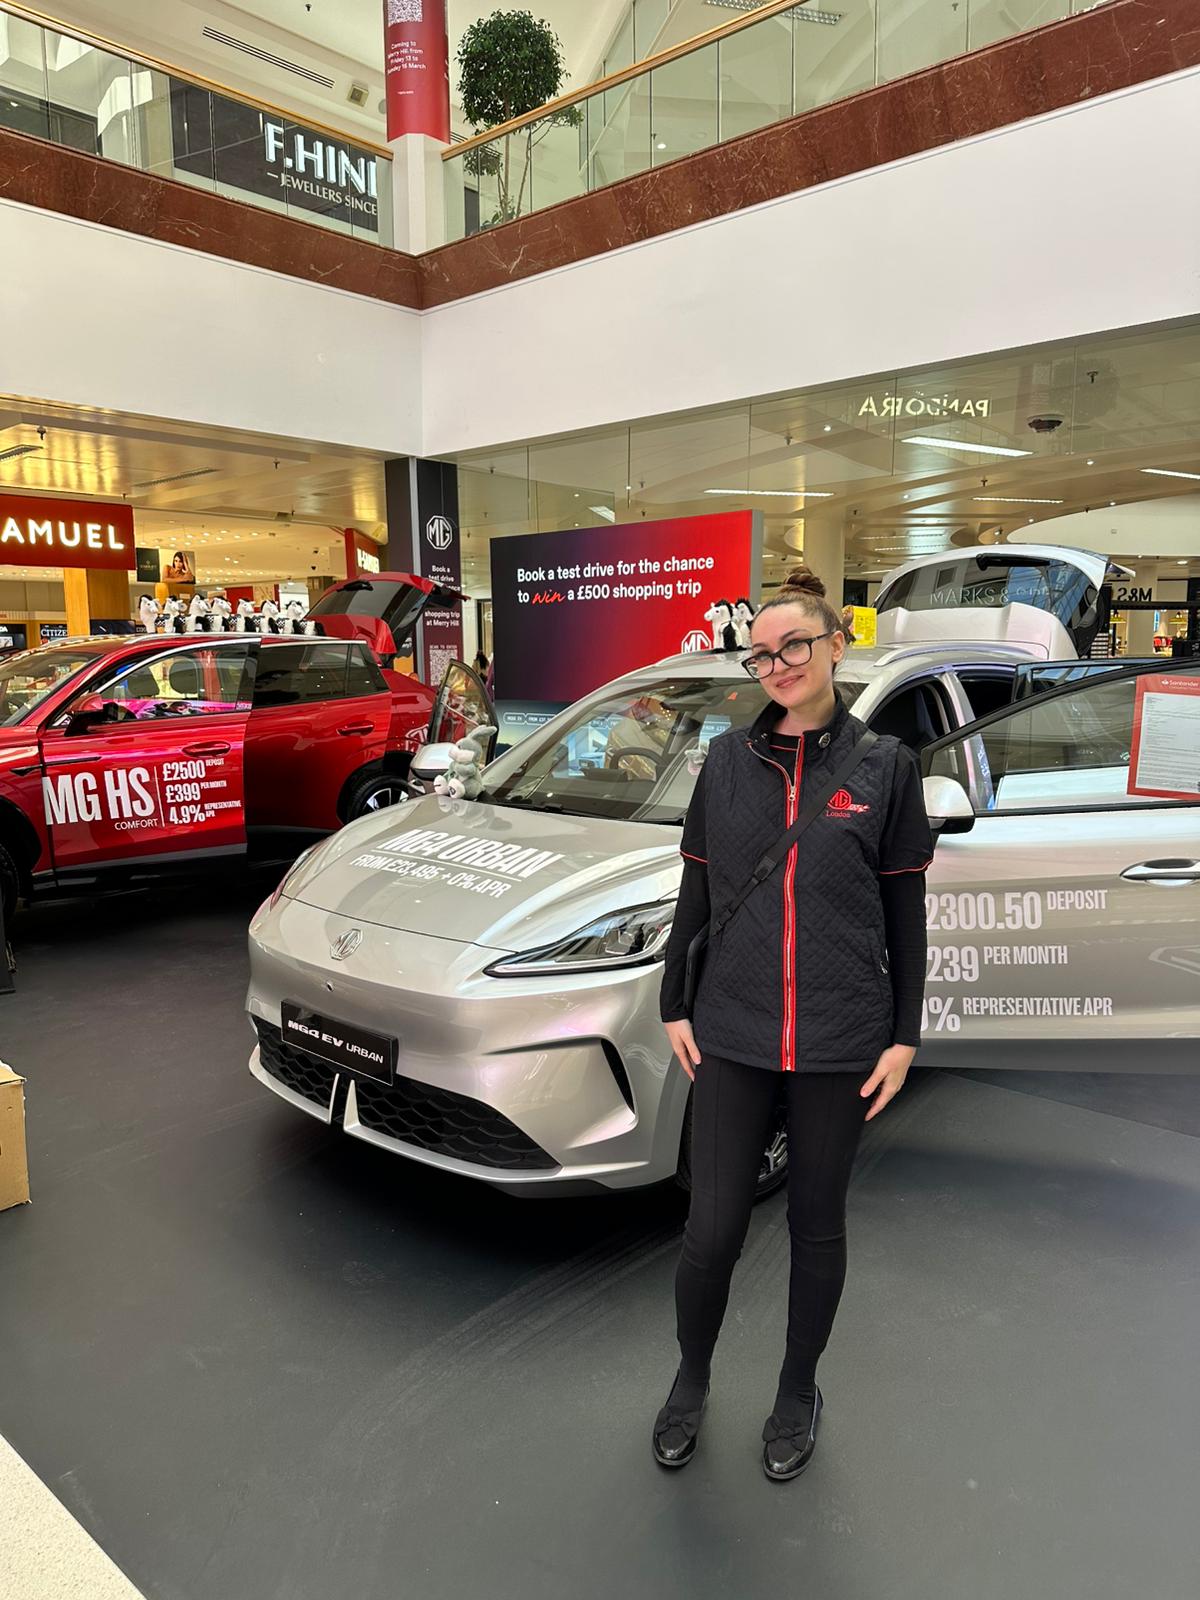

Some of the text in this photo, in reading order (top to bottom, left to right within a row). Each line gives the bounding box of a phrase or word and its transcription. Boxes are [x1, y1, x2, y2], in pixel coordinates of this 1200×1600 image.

[280, 173, 377, 216] JEWELLERS SINCE
[427, 516, 452, 549] MG
[431, 565, 446, 573] Book
[517, 555, 714, 582] Book a test drive for the chance
[517, 578, 702, 604] to win a £500 shopping trip
[930, 587, 995, 605] MARKS
[424, 610, 460, 619] shopping trip
[433, 620, 449, 628] Merry
[40, 628, 68, 637] CITIZE
[163, 760, 206, 781] £2500
[42, 766, 156, 825] MG HS
[165, 782, 201, 803] £399
[115, 818, 158, 831] COMFORT
[169, 804, 206, 825] 4.9%
[376, 828, 566, 878] MG4 URBAN
[350, 854, 394, 870] FROM
[381, 858, 446, 880] £23,495
[447, 872, 481, 889] 0%
[470, 879, 513, 898] APR
[1046, 890, 1108, 910] DEPOSIT
[984, 945, 1011, 965] PER
[1013, 945, 1068, 965] MONTH
[962, 997, 1081, 1016] REPRESENTATIVE
[1083, 998, 1113, 1016] APR
[321, 1033, 344, 1047] EV
[346, 1042, 384, 1064] URBAN
